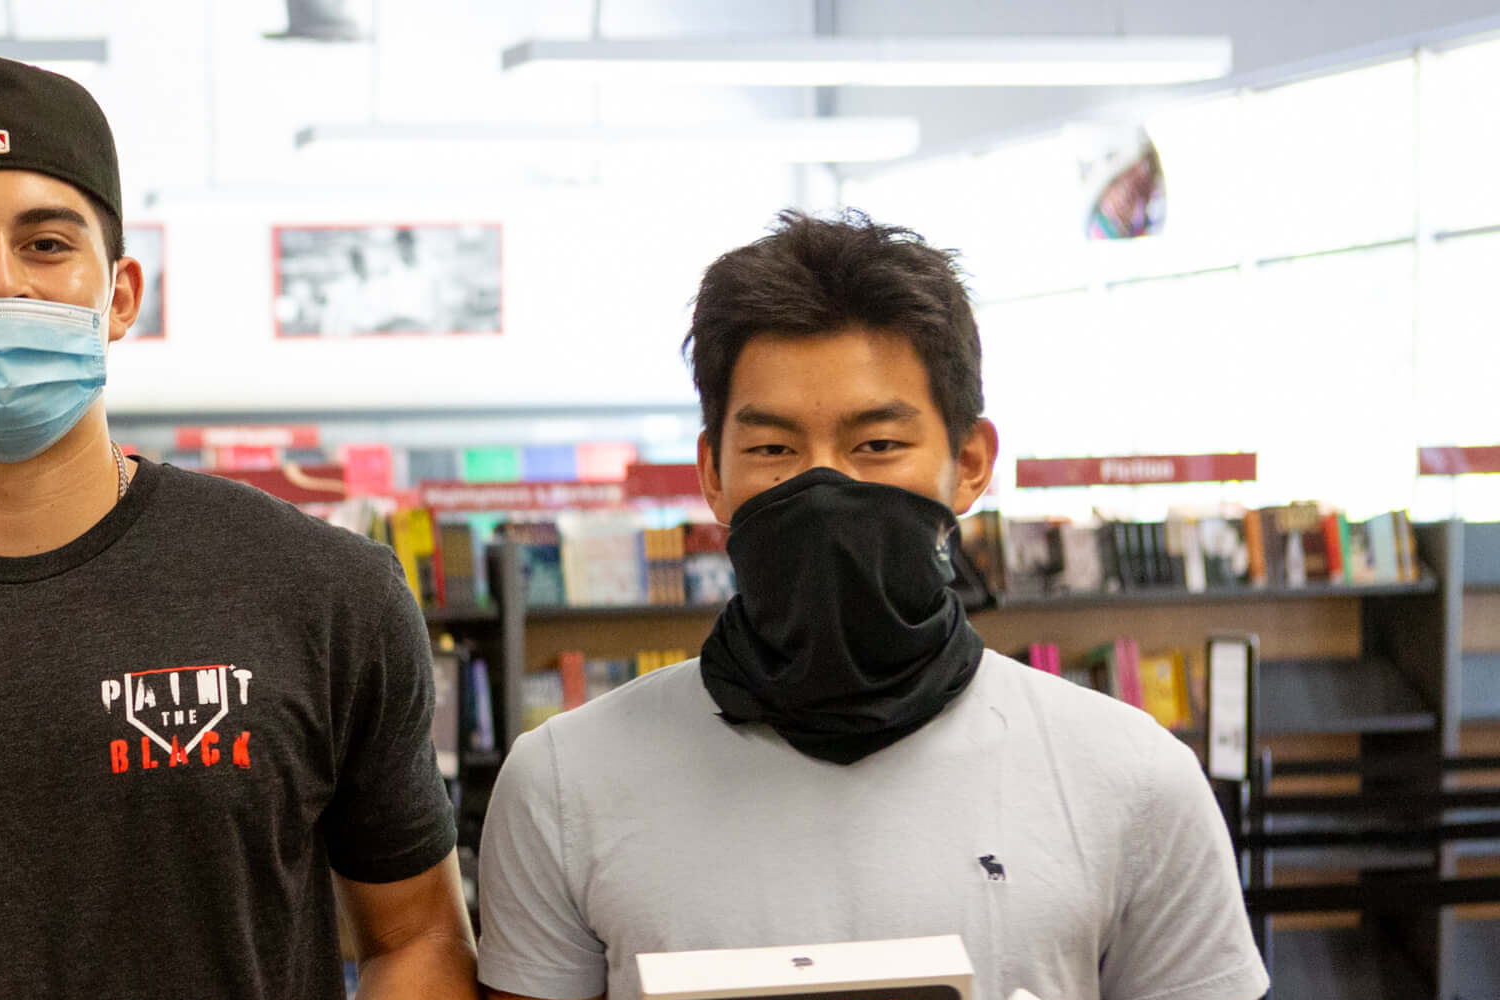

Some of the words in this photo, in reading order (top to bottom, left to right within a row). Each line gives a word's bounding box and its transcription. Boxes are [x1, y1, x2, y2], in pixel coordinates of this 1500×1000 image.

[101, 668, 253, 715] PAINT
[161, 709, 197, 726] THE
[110, 730, 252, 775] BLACK
